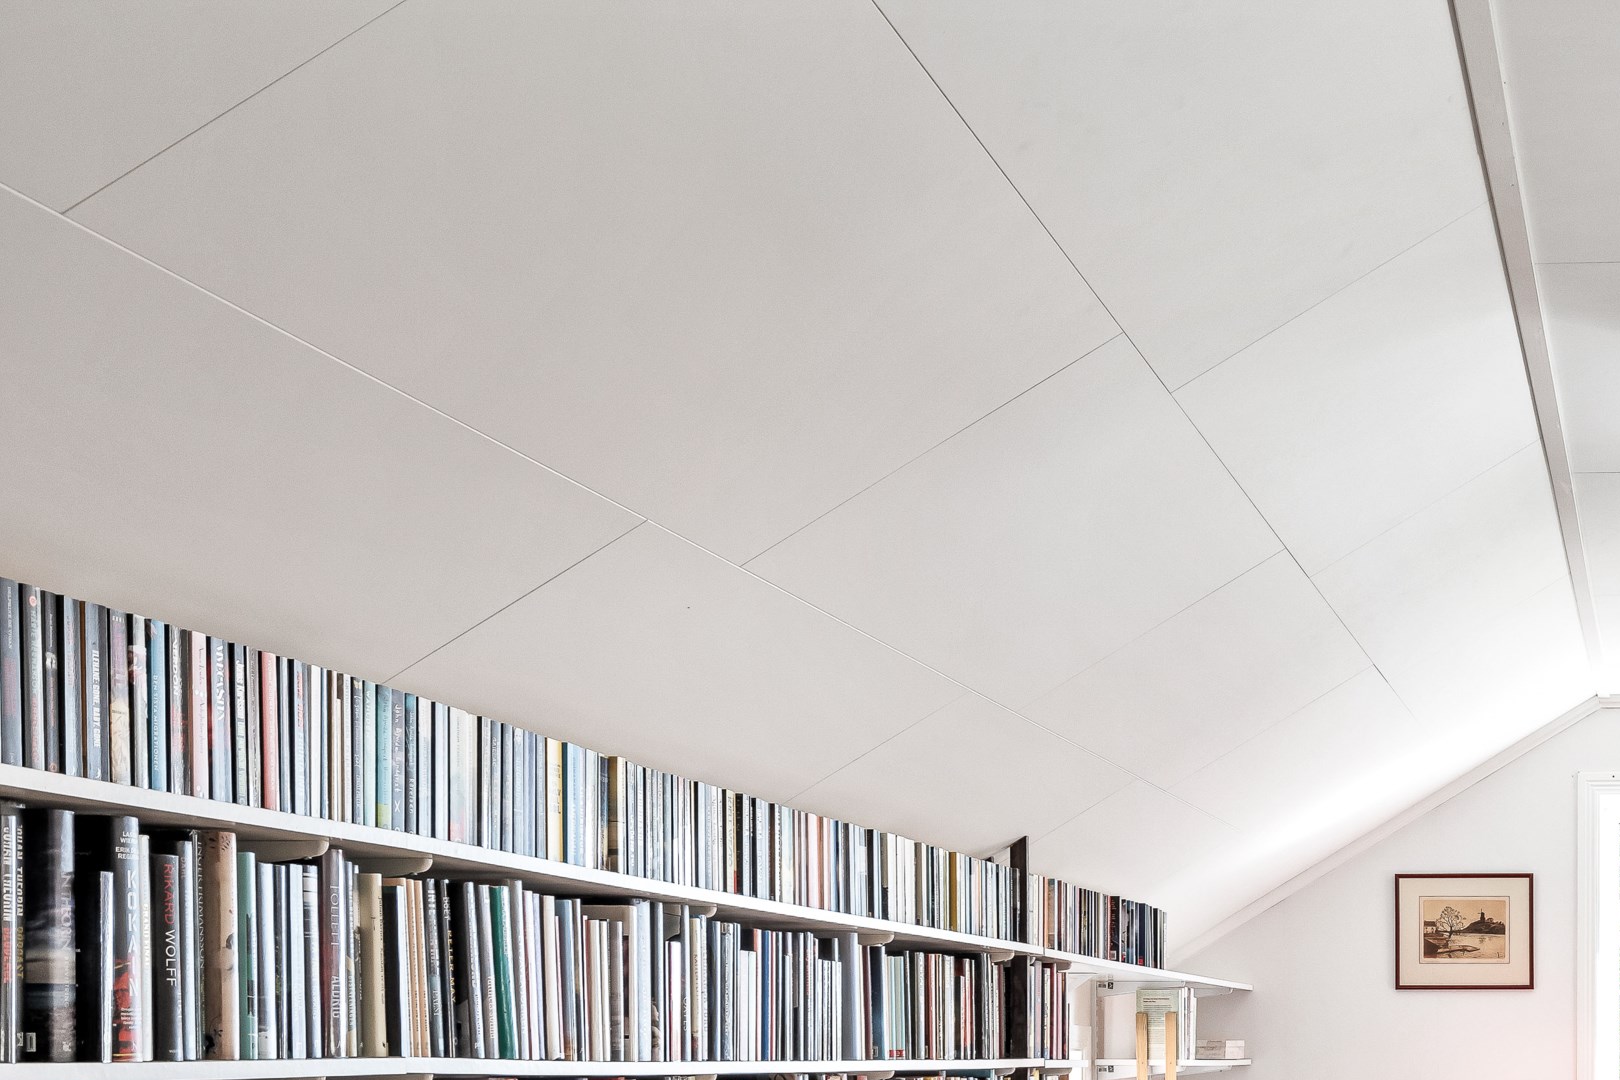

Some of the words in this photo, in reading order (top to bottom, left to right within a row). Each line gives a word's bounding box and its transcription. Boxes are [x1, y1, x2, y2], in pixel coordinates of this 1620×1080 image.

[172, 639, 180, 696] VERDON
[164, 862, 174, 925] RIKARD
[330, 885, 340, 946] FOLLETT
[127, 869, 139, 998] KOKAIN
[165, 930, 176, 987] WOLFF
